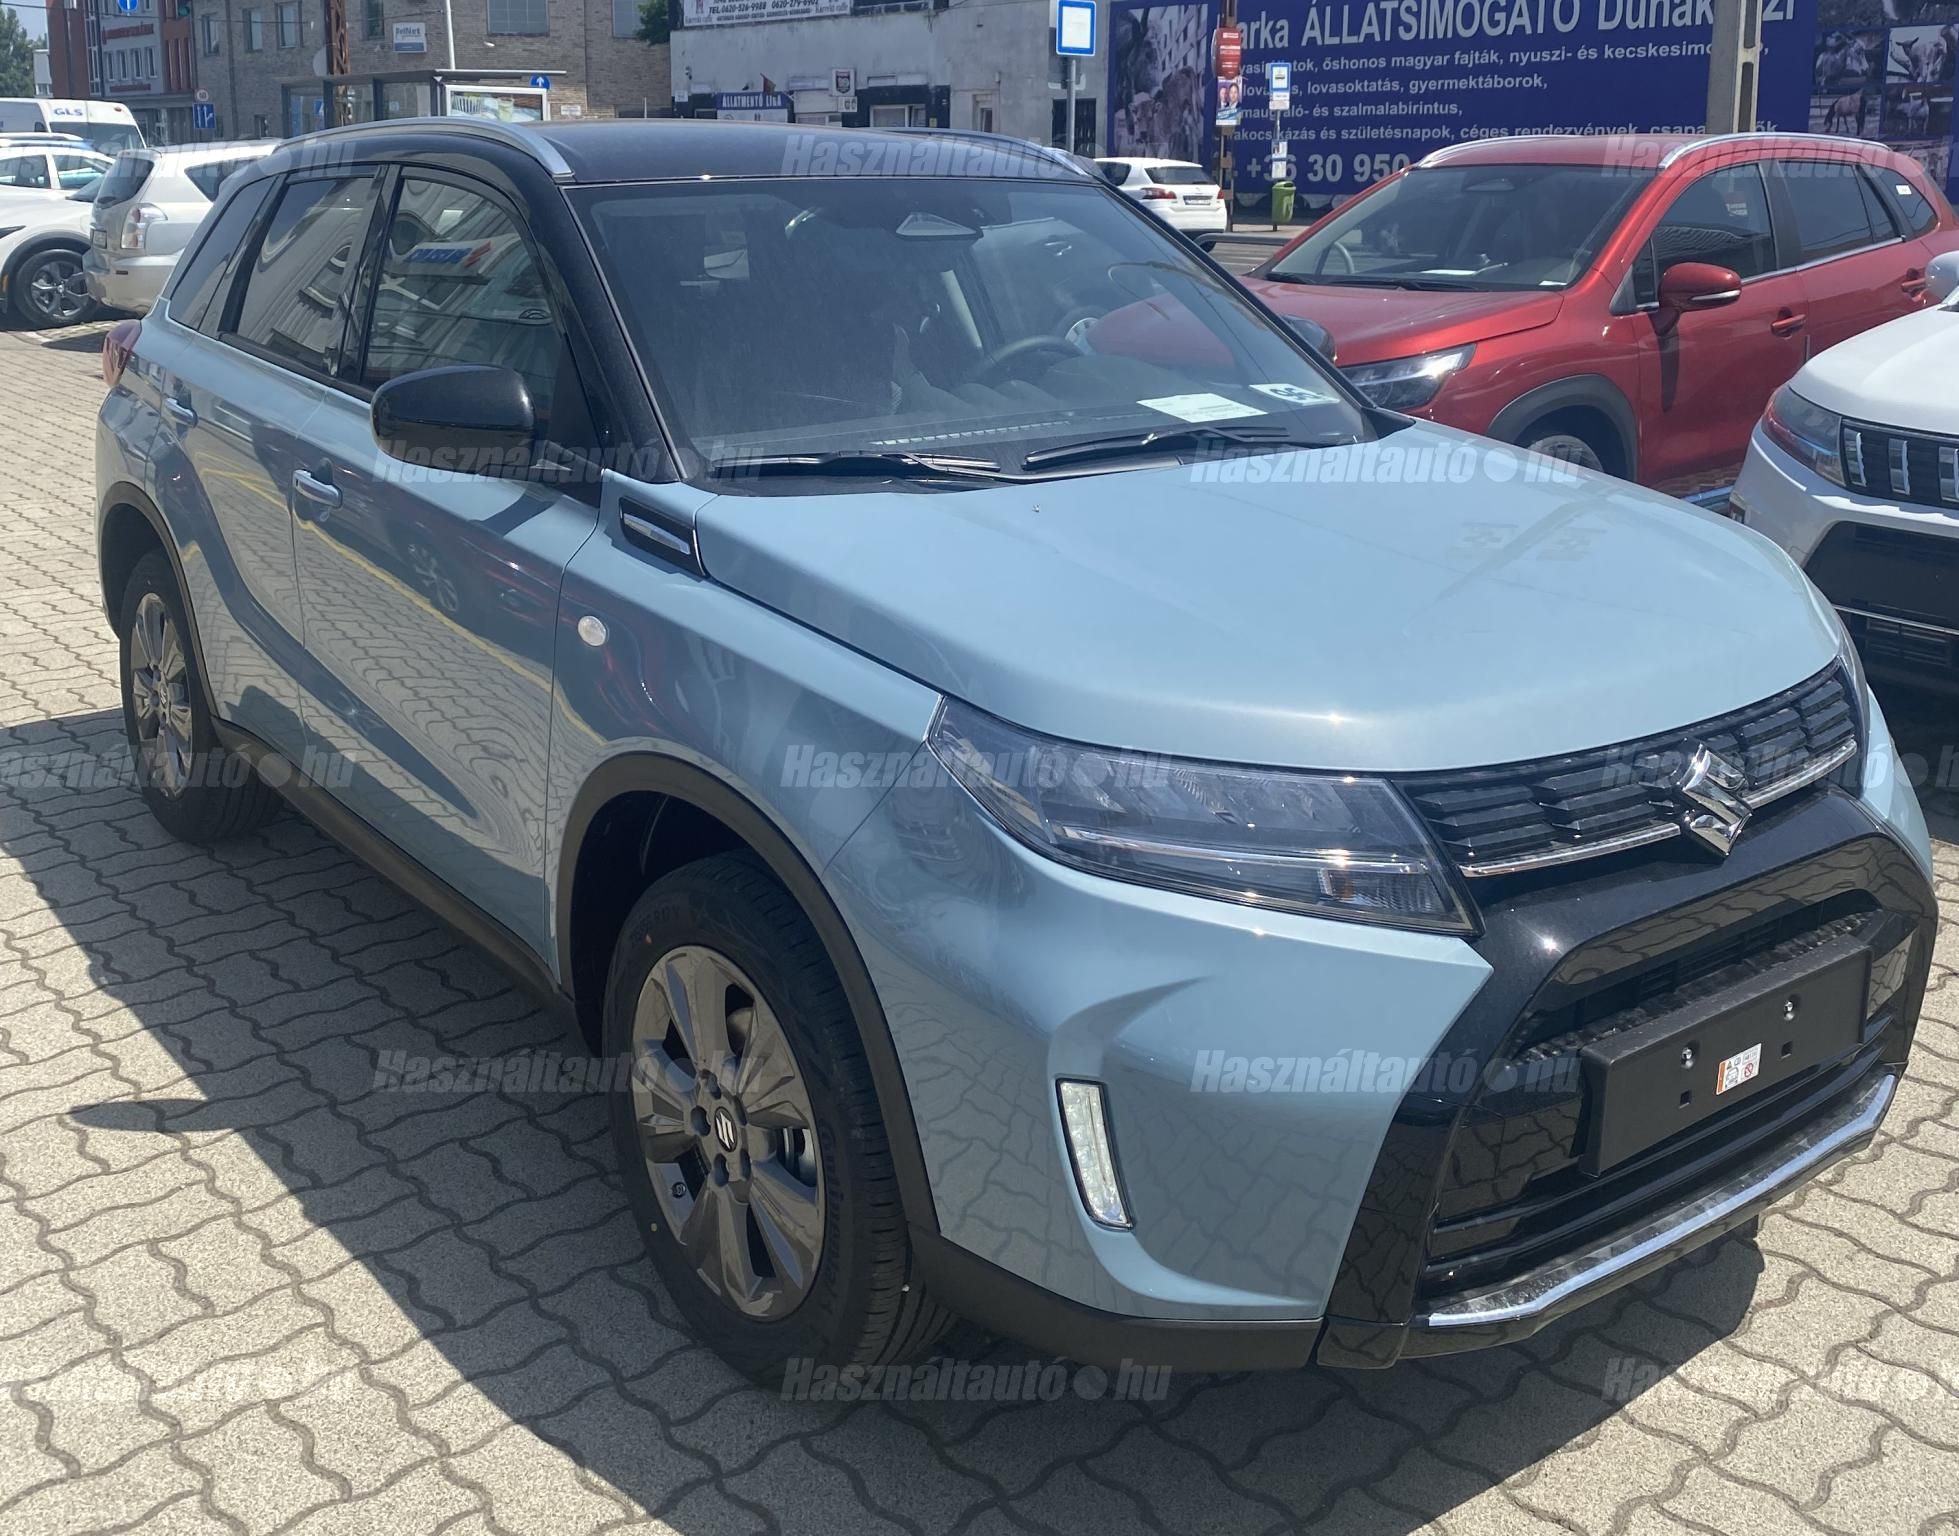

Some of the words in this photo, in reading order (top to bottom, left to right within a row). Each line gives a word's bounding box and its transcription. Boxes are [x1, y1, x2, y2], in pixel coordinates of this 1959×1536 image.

[1239, 11, 1289, 49] arka
[1597, 0, 1796, 30] Dunakzi
[1323, 56, 1387, 72] őshonos
[1391, 54, 1450, 71] magyar
[1454, 50, 1504, 68] fajták,
[1509, 46, 1573, 66] nyuszi-
[1577, 44, 1598, 60] és
[1307, 78, 1404, 96] lovasoktatás,
[1409, 73, 1548, 94] gyermektáborok,
[54, 107, 83, 116] GLS
[1312, 103, 1330, 117] és
[1333, 101, 1463, 117] szalmalabirintus,
[1320, 126, 1337, 140] és
[1340, 124, 1455, 143] születésnapok,
[1460, 124, 1509, 138] céges
[1307, 153, 1343, 182] 30
[1353, 152, 1410, 182] 950
